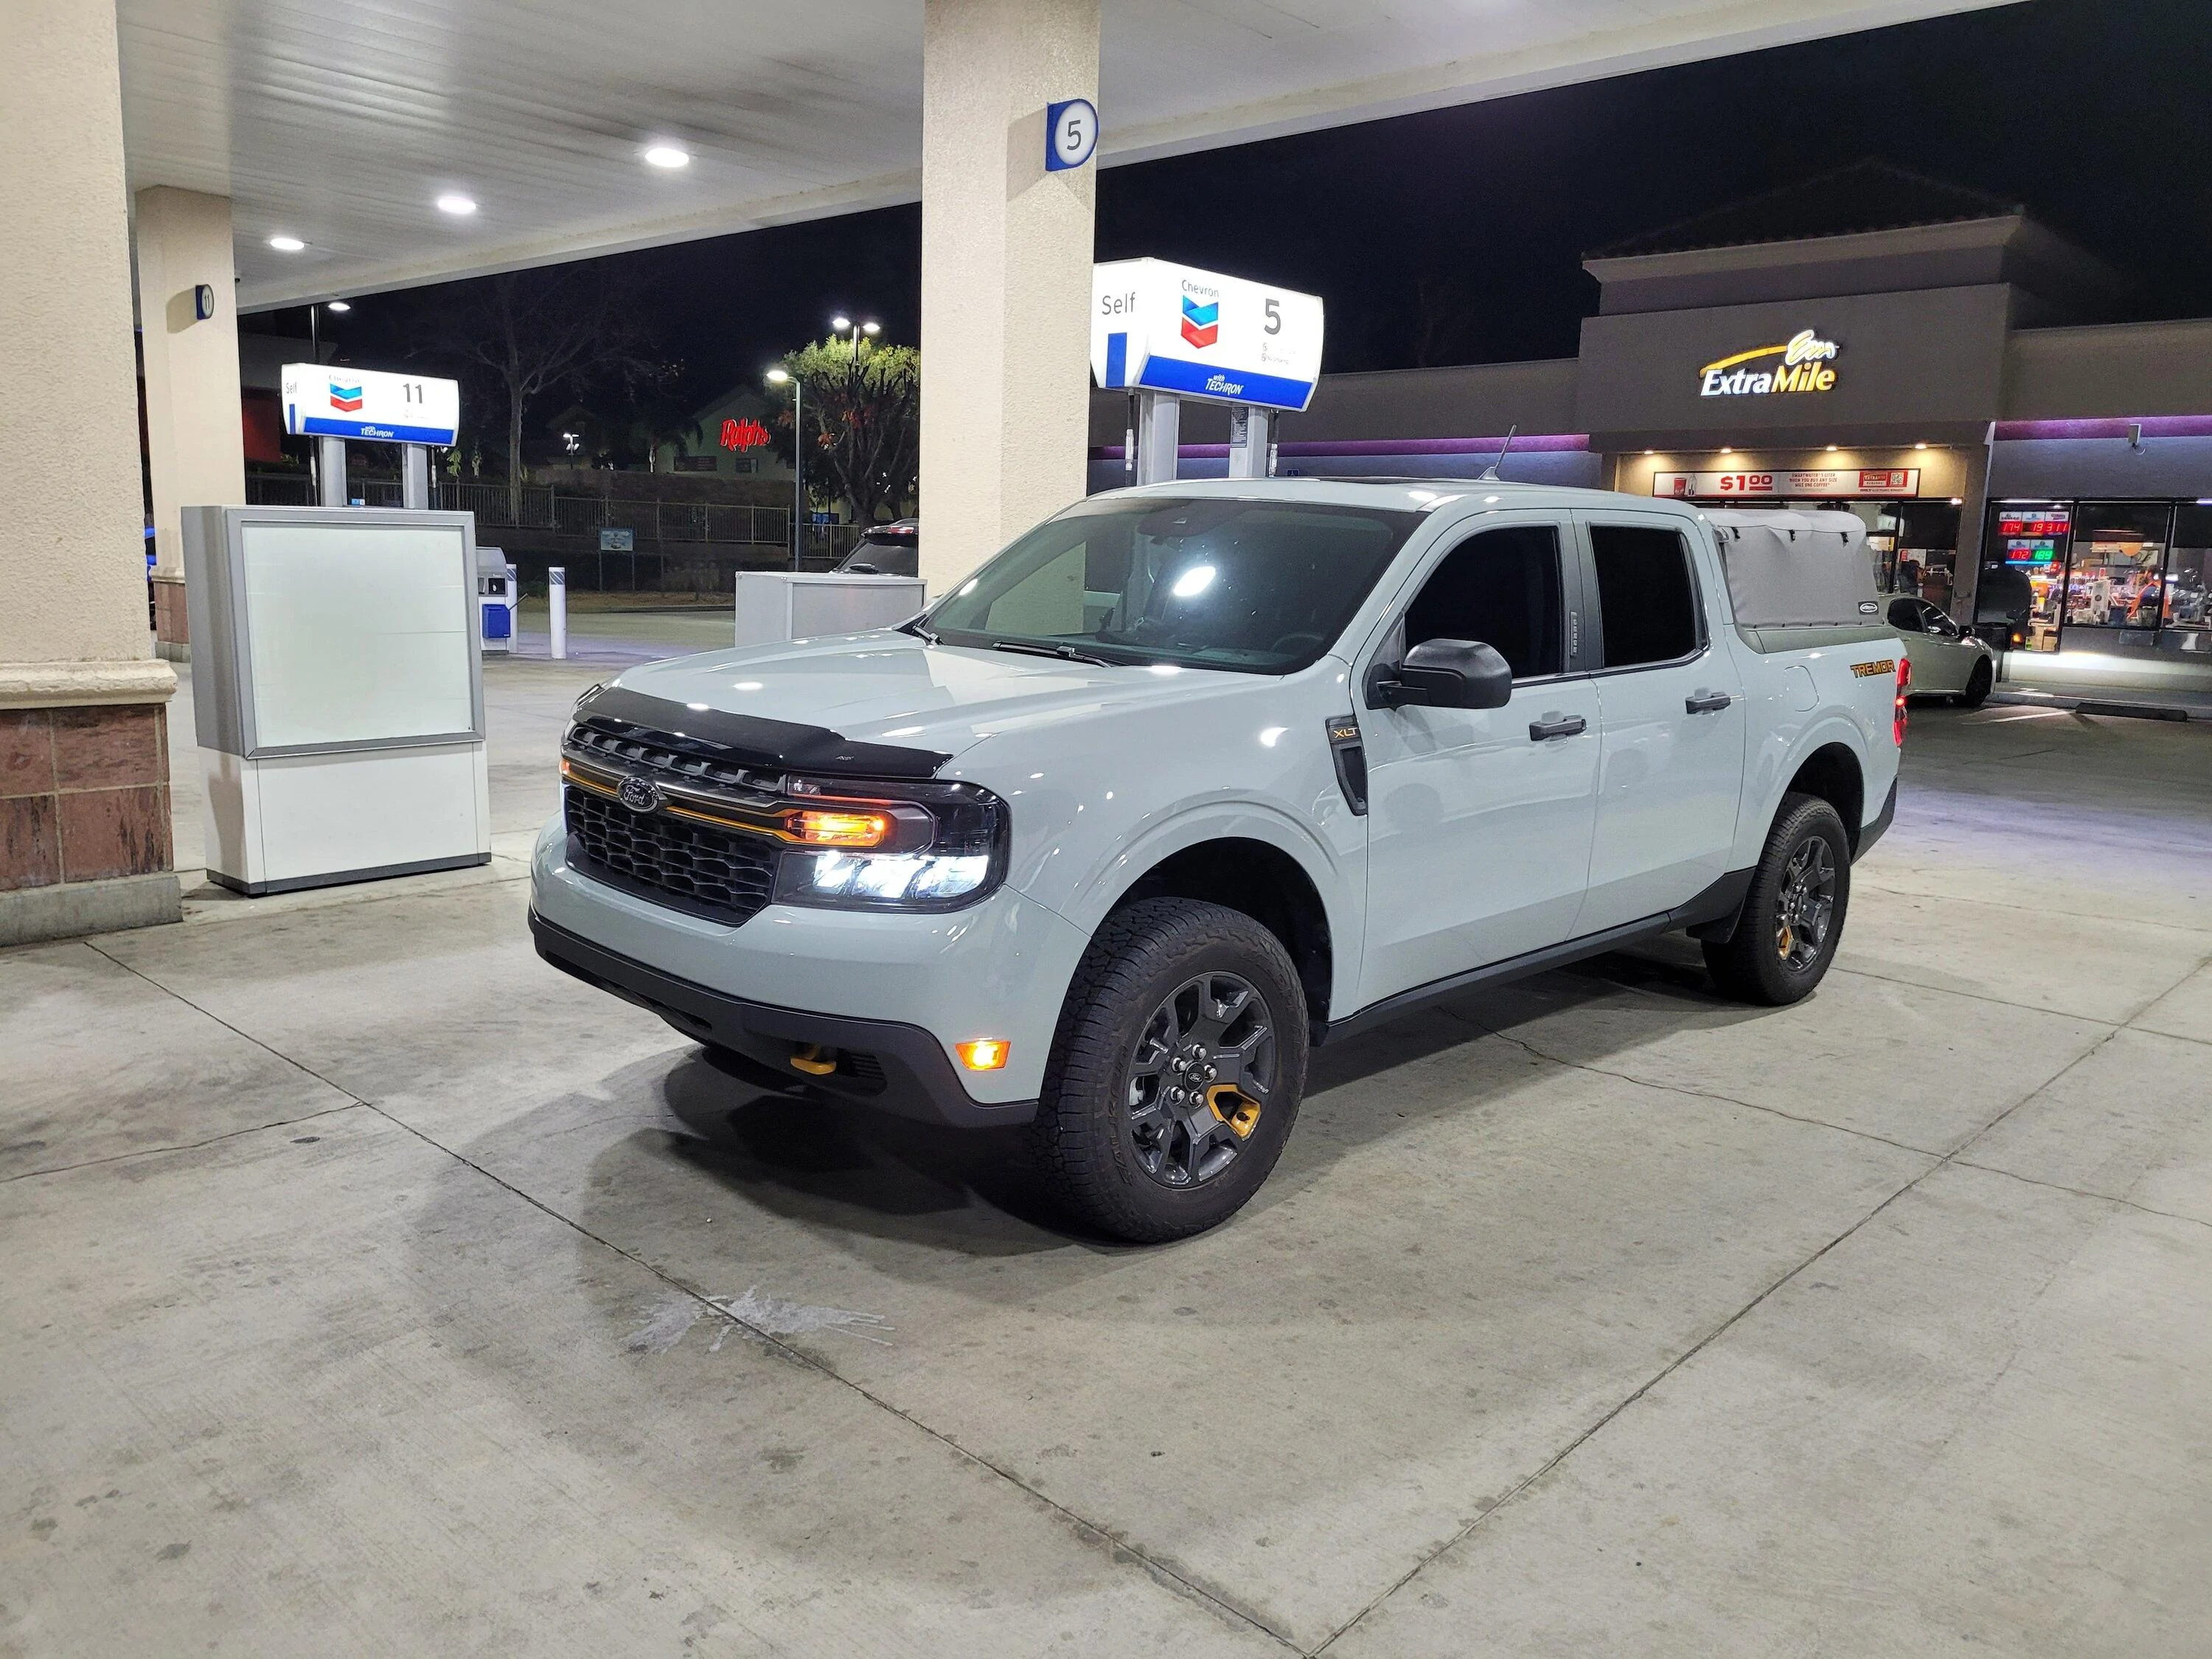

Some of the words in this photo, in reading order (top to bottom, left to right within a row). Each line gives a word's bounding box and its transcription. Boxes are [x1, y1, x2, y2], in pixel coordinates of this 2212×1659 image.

[1066, 119, 1082, 150] 5
[1181, 279, 1220, 297] Chevron
[1102, 291, 1136, 315] Self
[1264, 298, 1281, 335] 5
[1205, 378, 1245, 396] TECHRON
[1213, 374, 1225, 382] with
[1700, 361, 1836, 397] ExtraMile
[403, 383, 423, 404] 11
[361, 427, 394, 438] TECHRON
[720, 416, 771, 453] Ralphs
[1849, 659, 1896, 678] TREMOR
[1333, 727, 1358, 739] XLT
[623, 784, 647, 806] Ford
